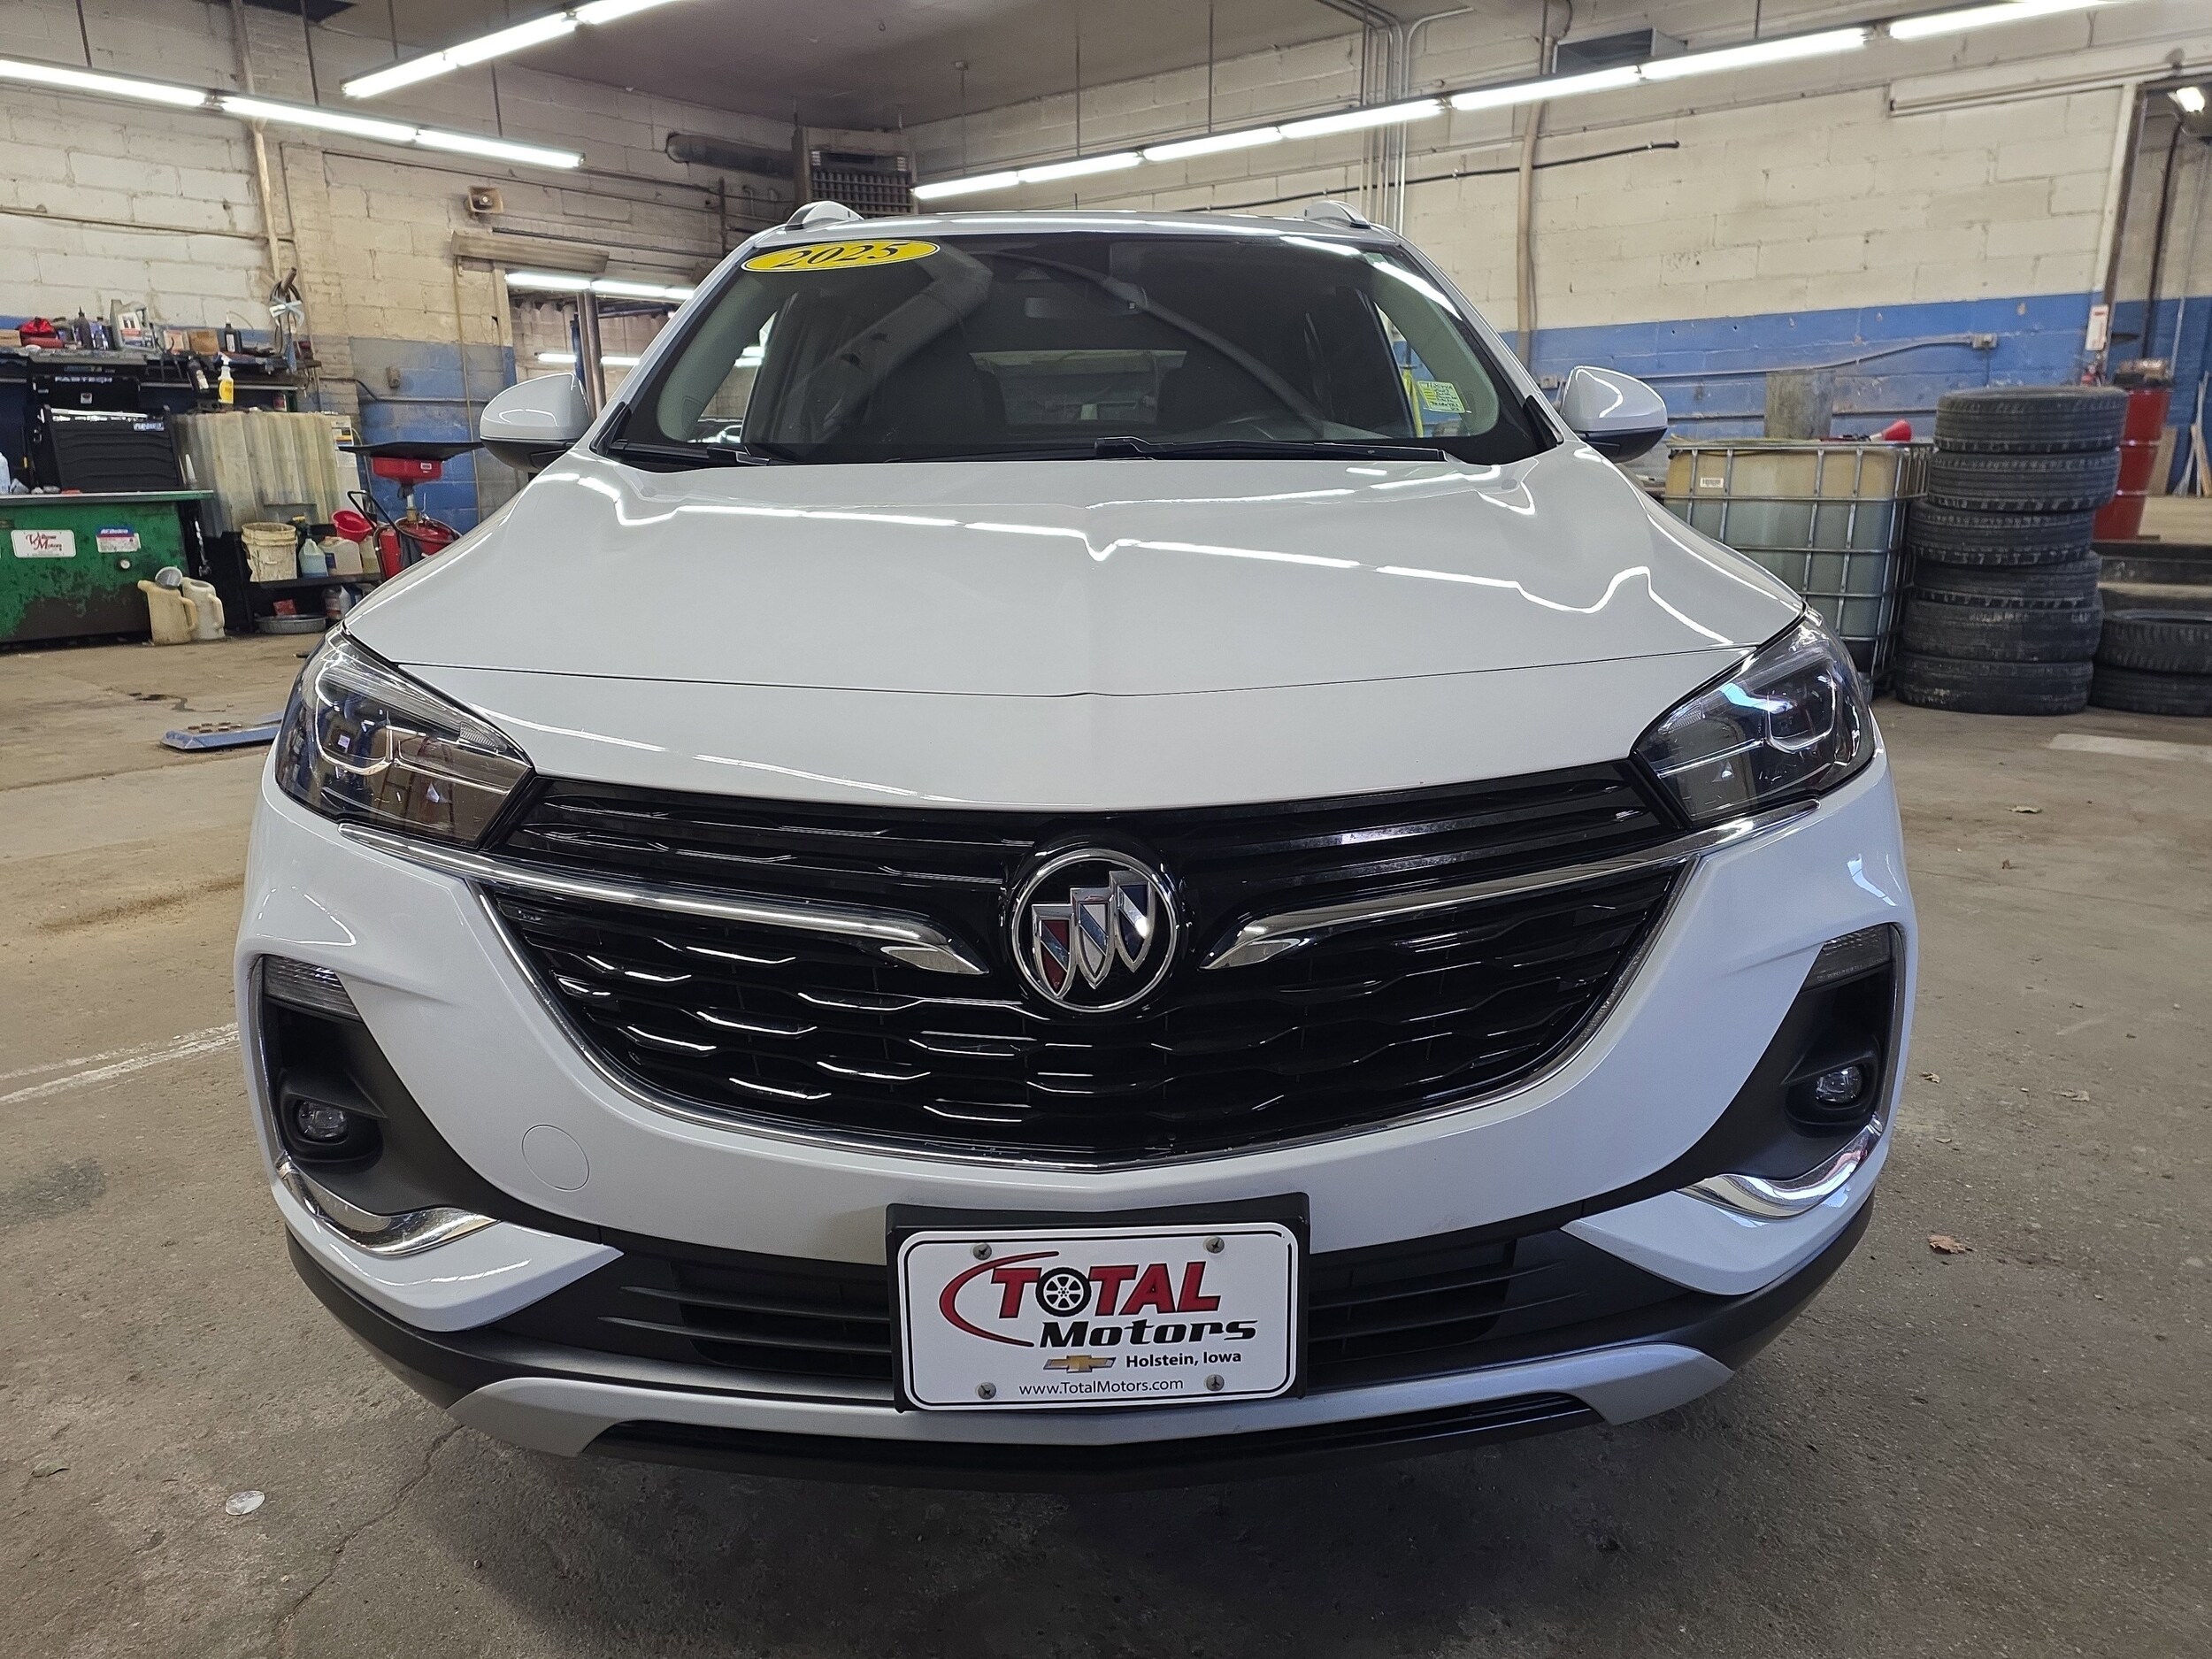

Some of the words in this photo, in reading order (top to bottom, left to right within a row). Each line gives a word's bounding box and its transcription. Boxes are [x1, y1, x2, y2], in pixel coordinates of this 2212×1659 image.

[772, 243, 909, 267] 2025
[990, 1261, 1222, 1318] TOTAL
[1039, 1319, 1258, 1348] Motors
[1125, 1354, 1199, 1368] Holstein,
[1202, 1350, 1241, 1364] Iowa
[1018, 1379, 1184, 1395] www.TotalMotors.com
